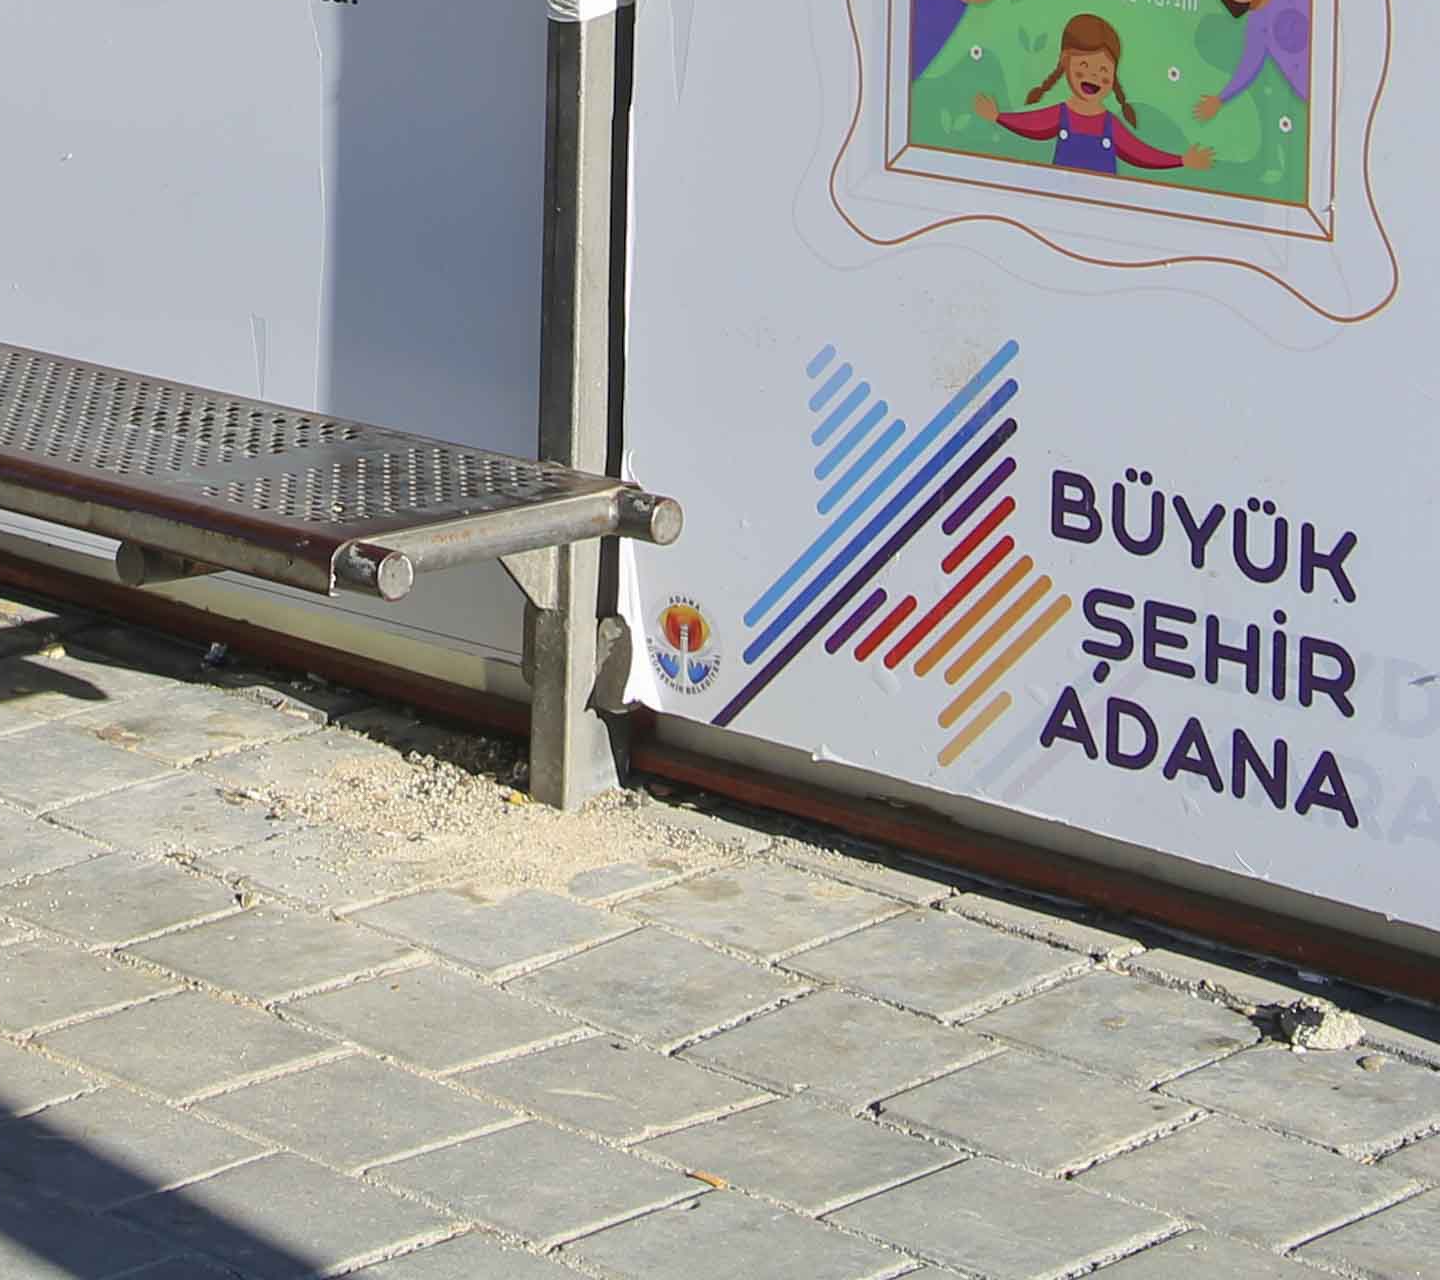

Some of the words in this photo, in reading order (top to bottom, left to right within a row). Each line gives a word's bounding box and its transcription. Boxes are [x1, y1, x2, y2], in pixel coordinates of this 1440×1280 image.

[1051, 468, 1359, 604] BÜYÜK
[1079, 587, 1358, 718] ŞEHİR
[1038, 685, 1360, 830] ADANA
